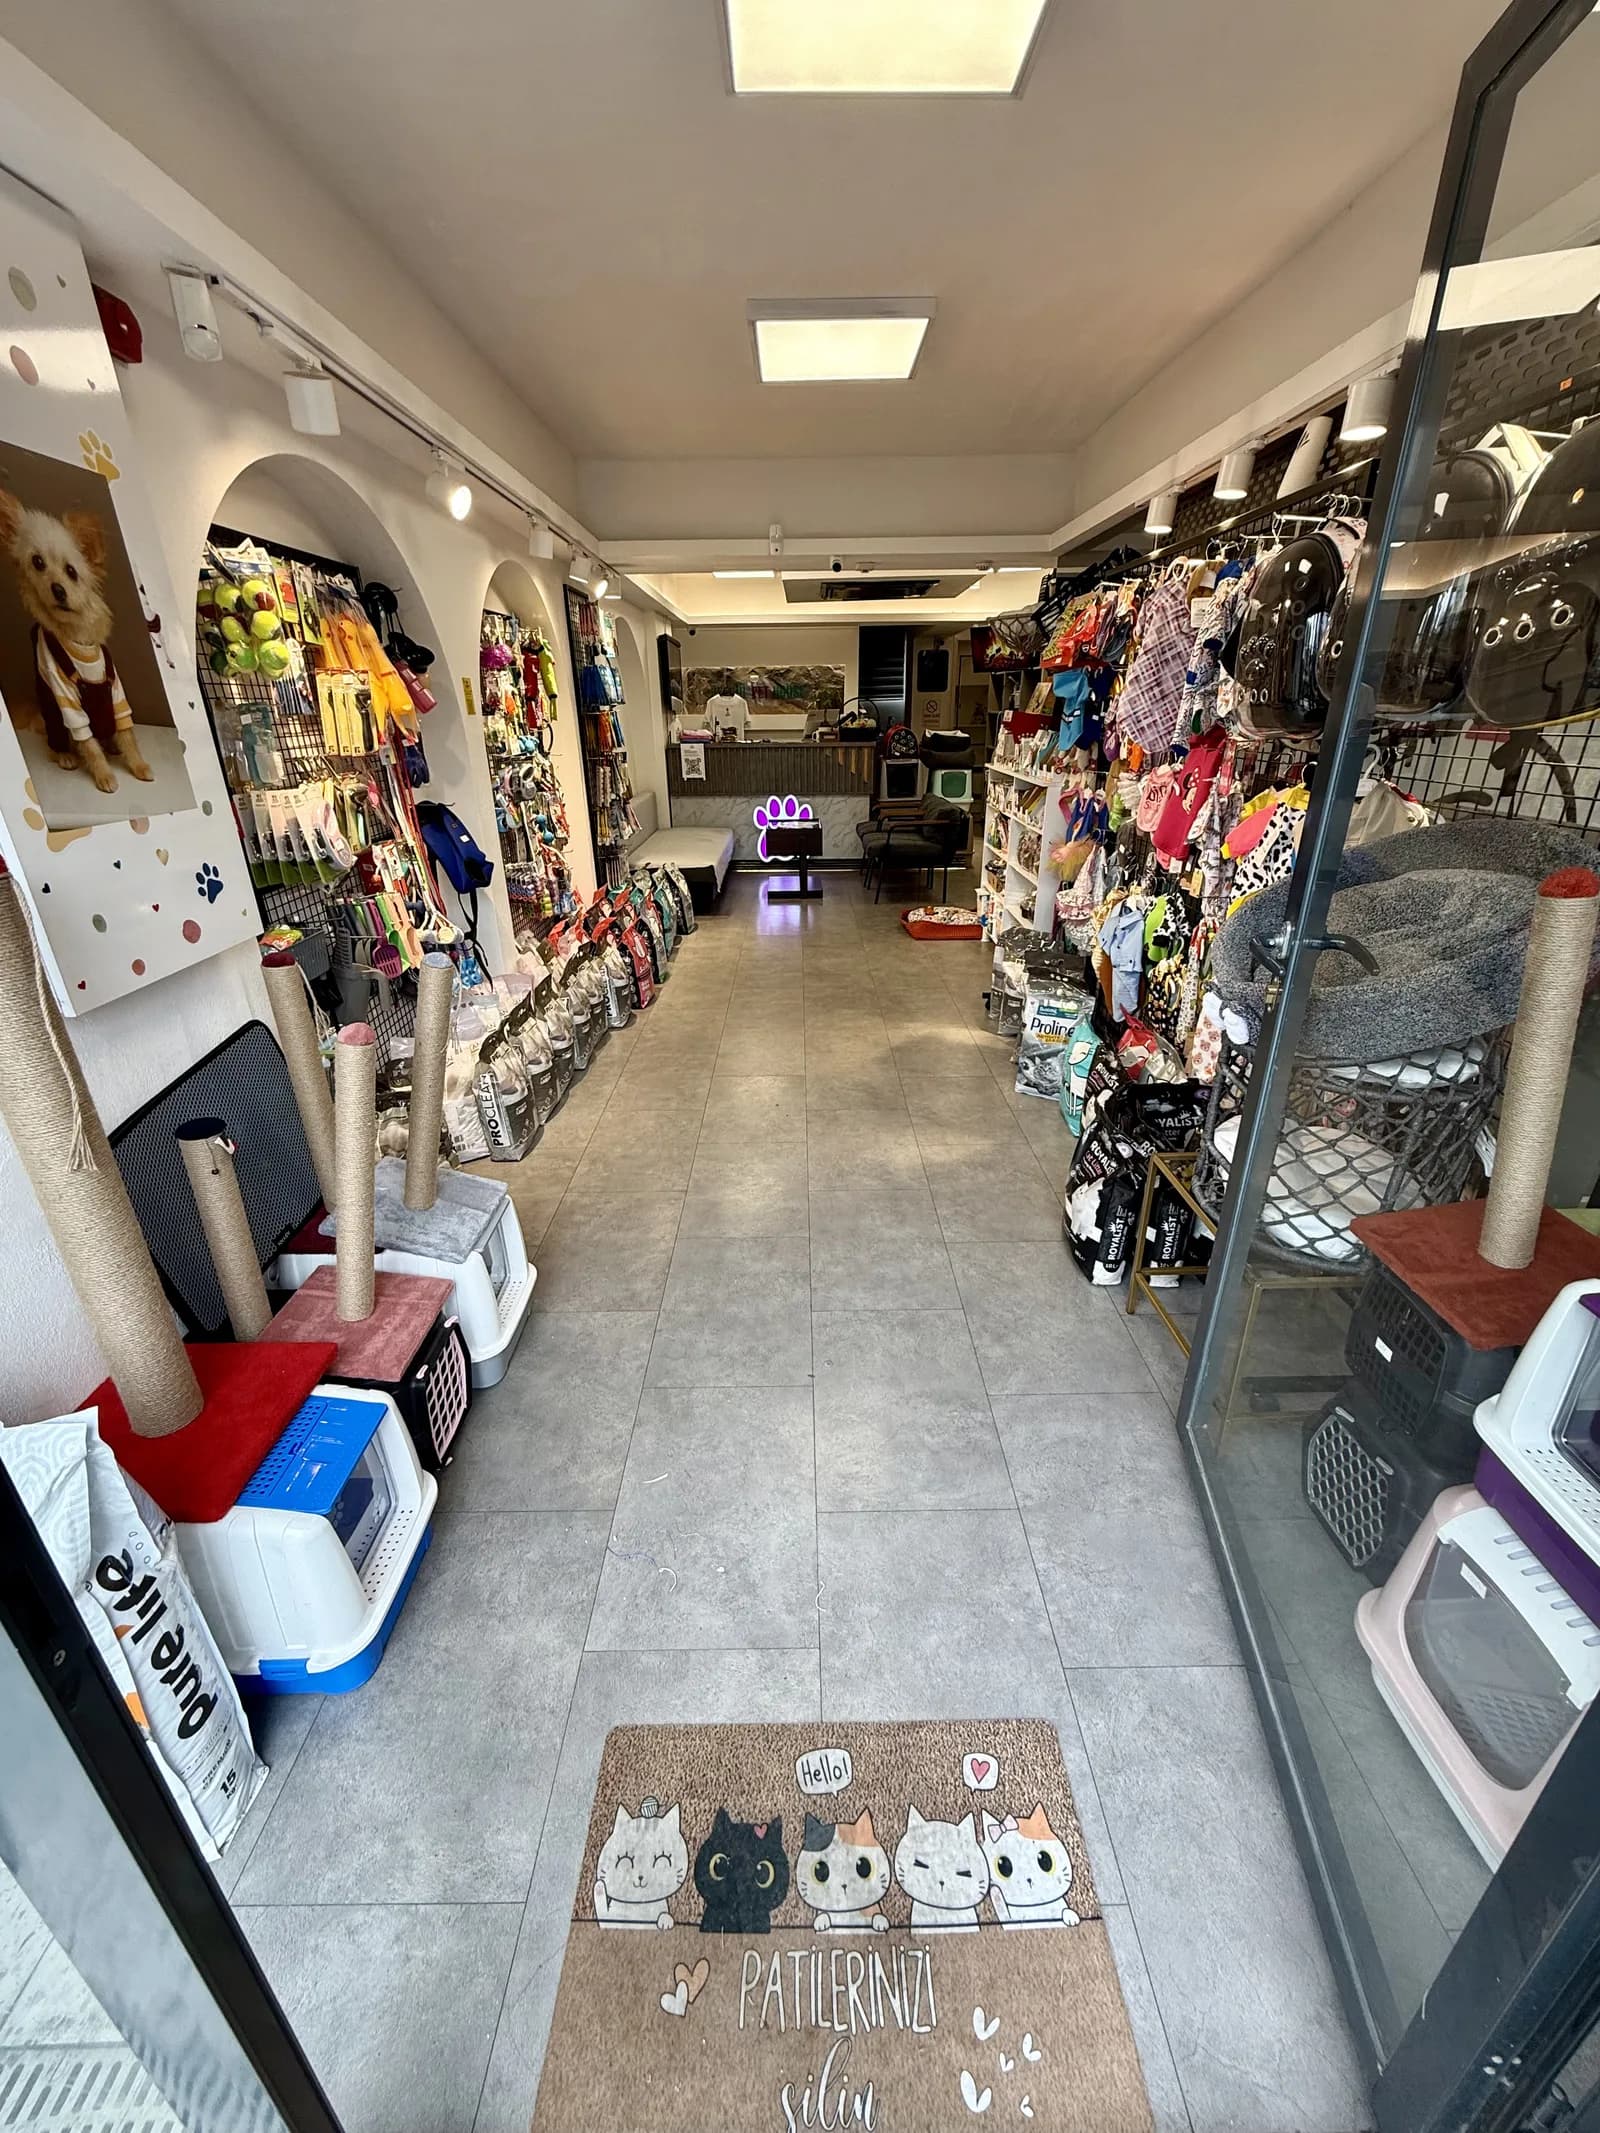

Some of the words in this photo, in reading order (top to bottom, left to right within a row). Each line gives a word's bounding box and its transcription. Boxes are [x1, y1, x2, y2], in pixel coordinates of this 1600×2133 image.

[96, 1549, 168, 1646] life
[151, 1624, 218, 1740] pure
[220, 1768, 237, 1794] 15
[801, 1754, 850, 1787] Hello!
[780, 2036, 881, 2133] silin
